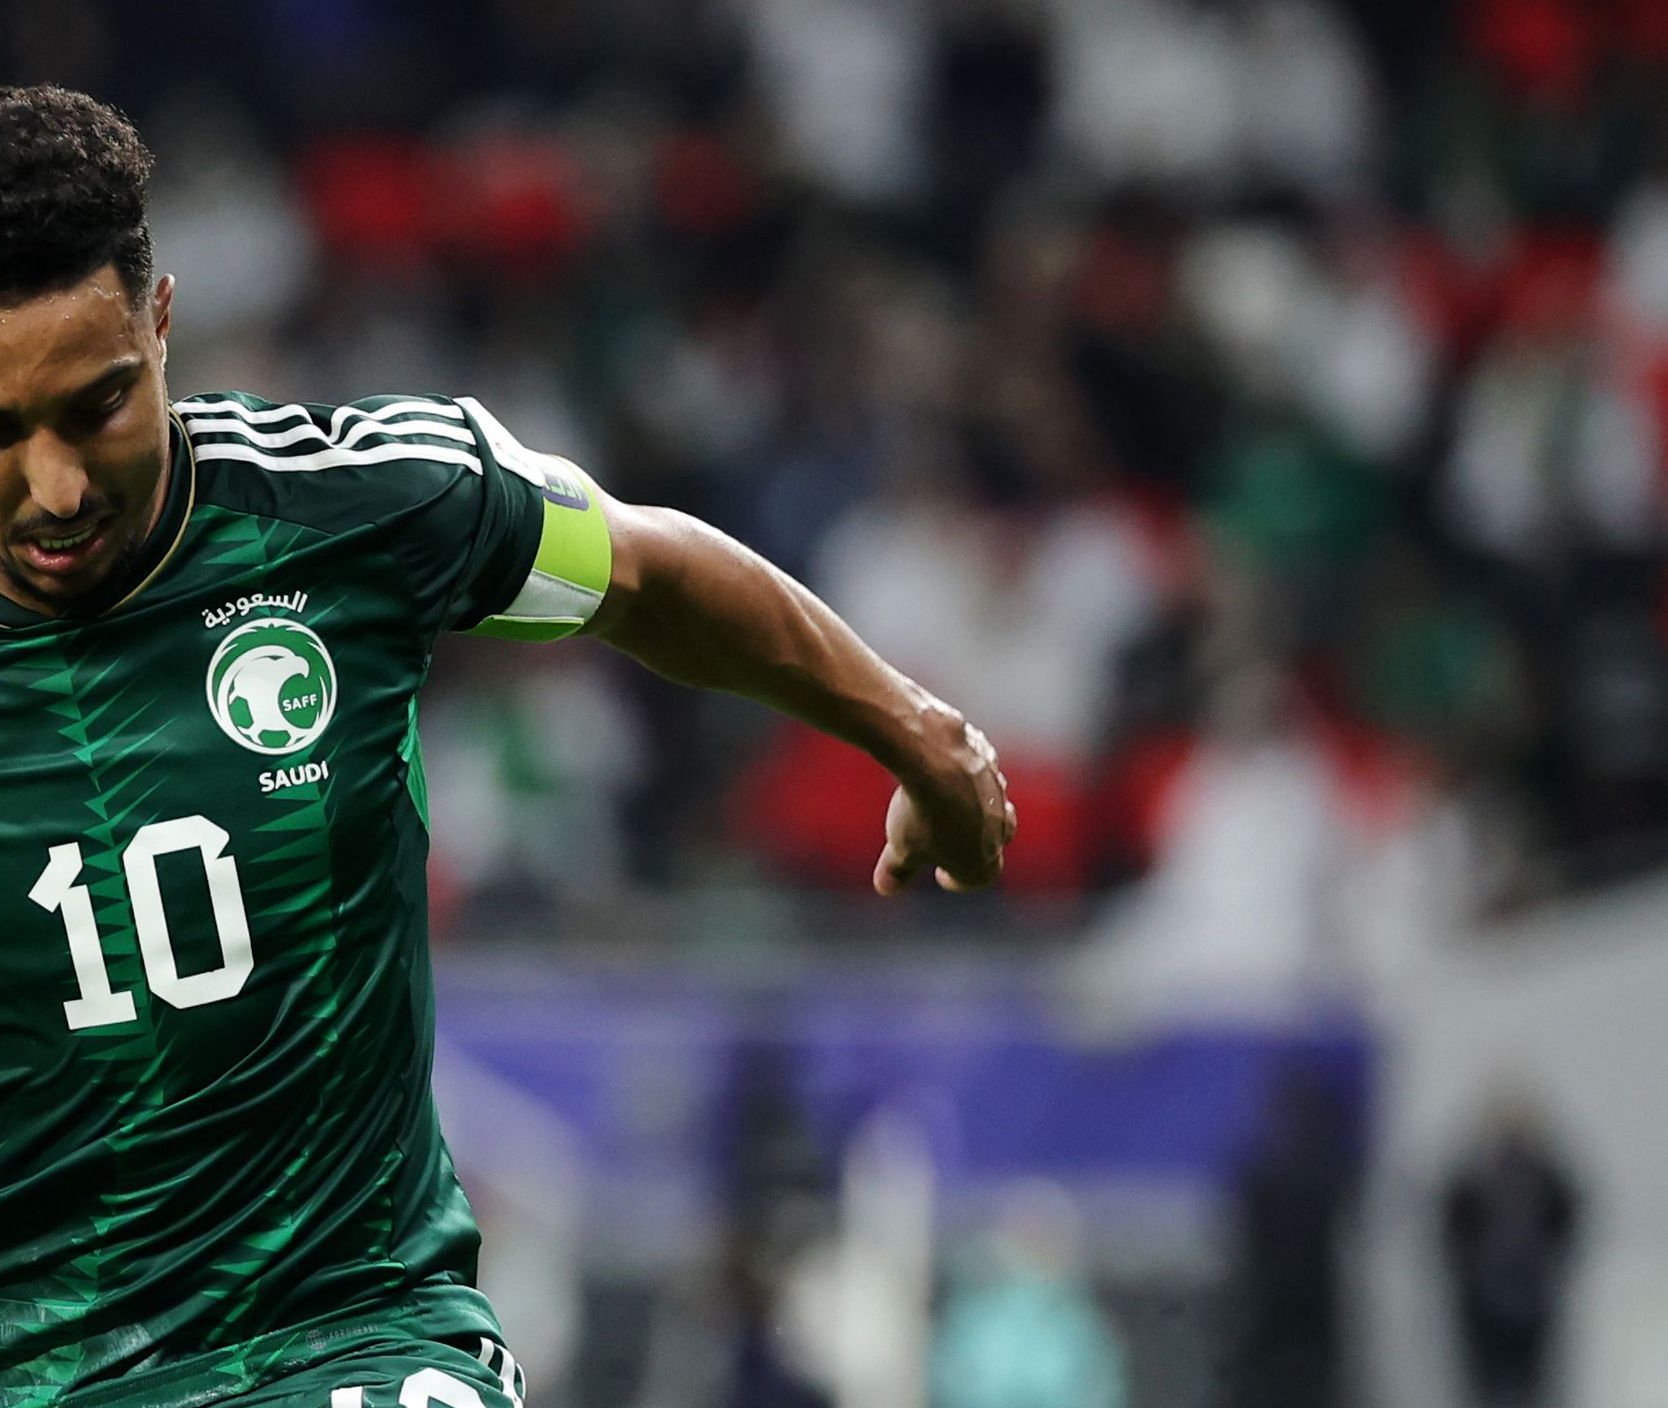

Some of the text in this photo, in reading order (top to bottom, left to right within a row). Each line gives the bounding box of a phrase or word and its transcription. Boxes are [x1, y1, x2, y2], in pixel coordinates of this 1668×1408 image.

[201, 590, 309, 629] السعودية
[282, 693, 318, 712] SAFF
[258, 760, 330, 793] SAUDI
[27, 814, 255, 1030] 10
